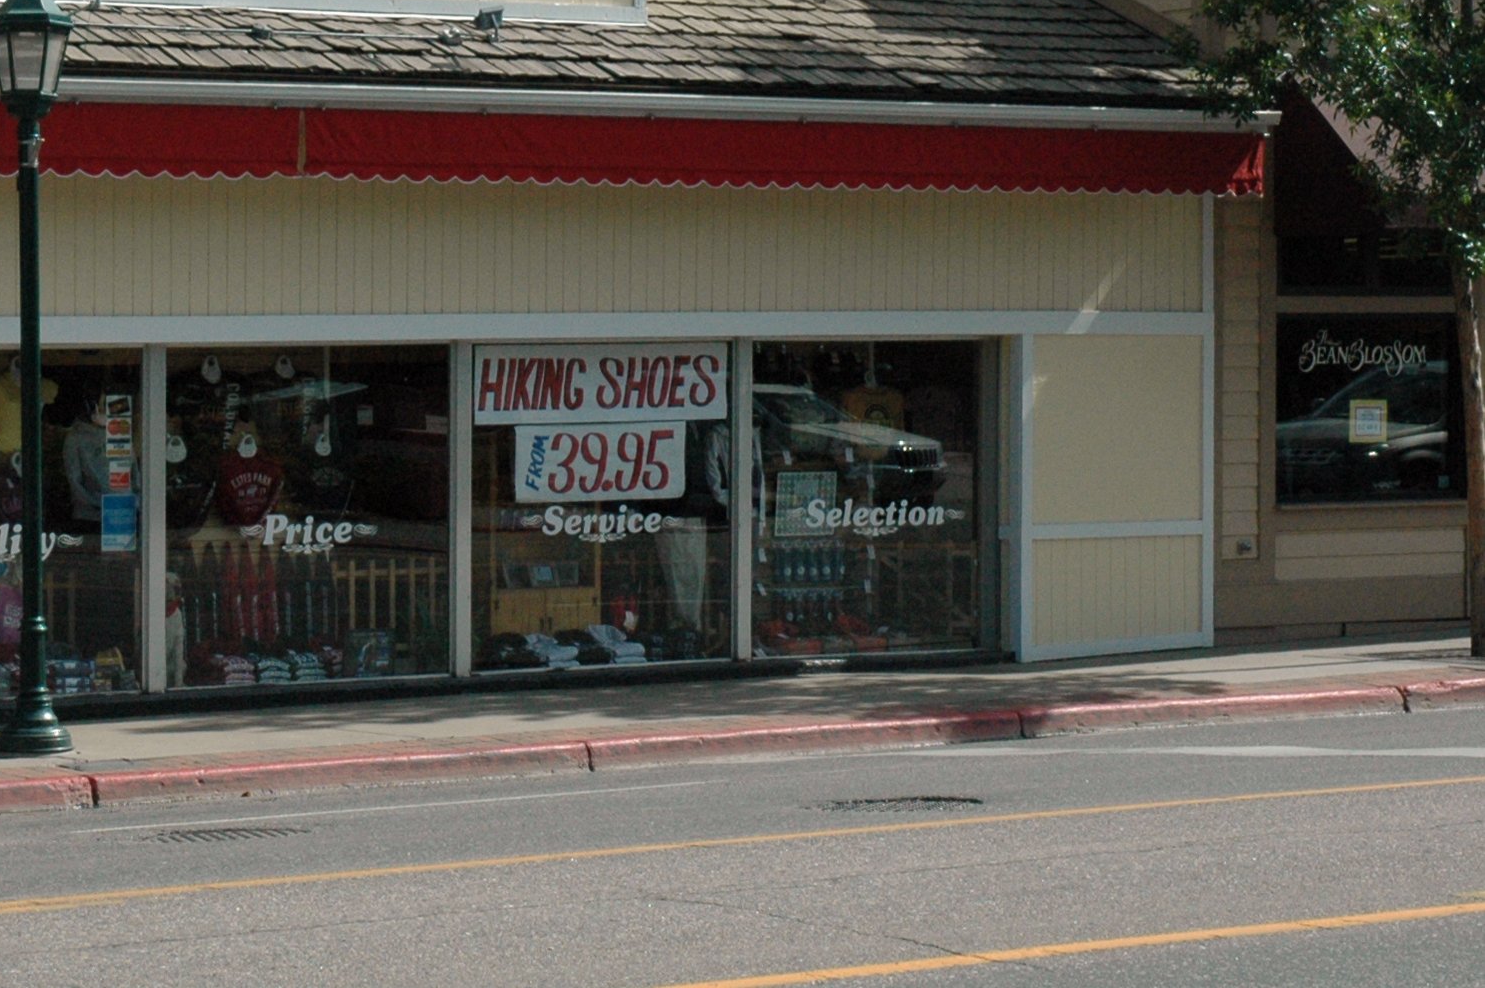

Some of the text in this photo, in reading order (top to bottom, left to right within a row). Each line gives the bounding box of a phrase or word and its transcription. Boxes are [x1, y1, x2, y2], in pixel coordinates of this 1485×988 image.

[478, 354, 720, 412] HIKING SHOES
[524, 429, 675, 495] FROM 39.95
[263, 514, 354, 546] Price
[542, 504, 663, 537] Service
[806, 499, 945, 528] Selection
